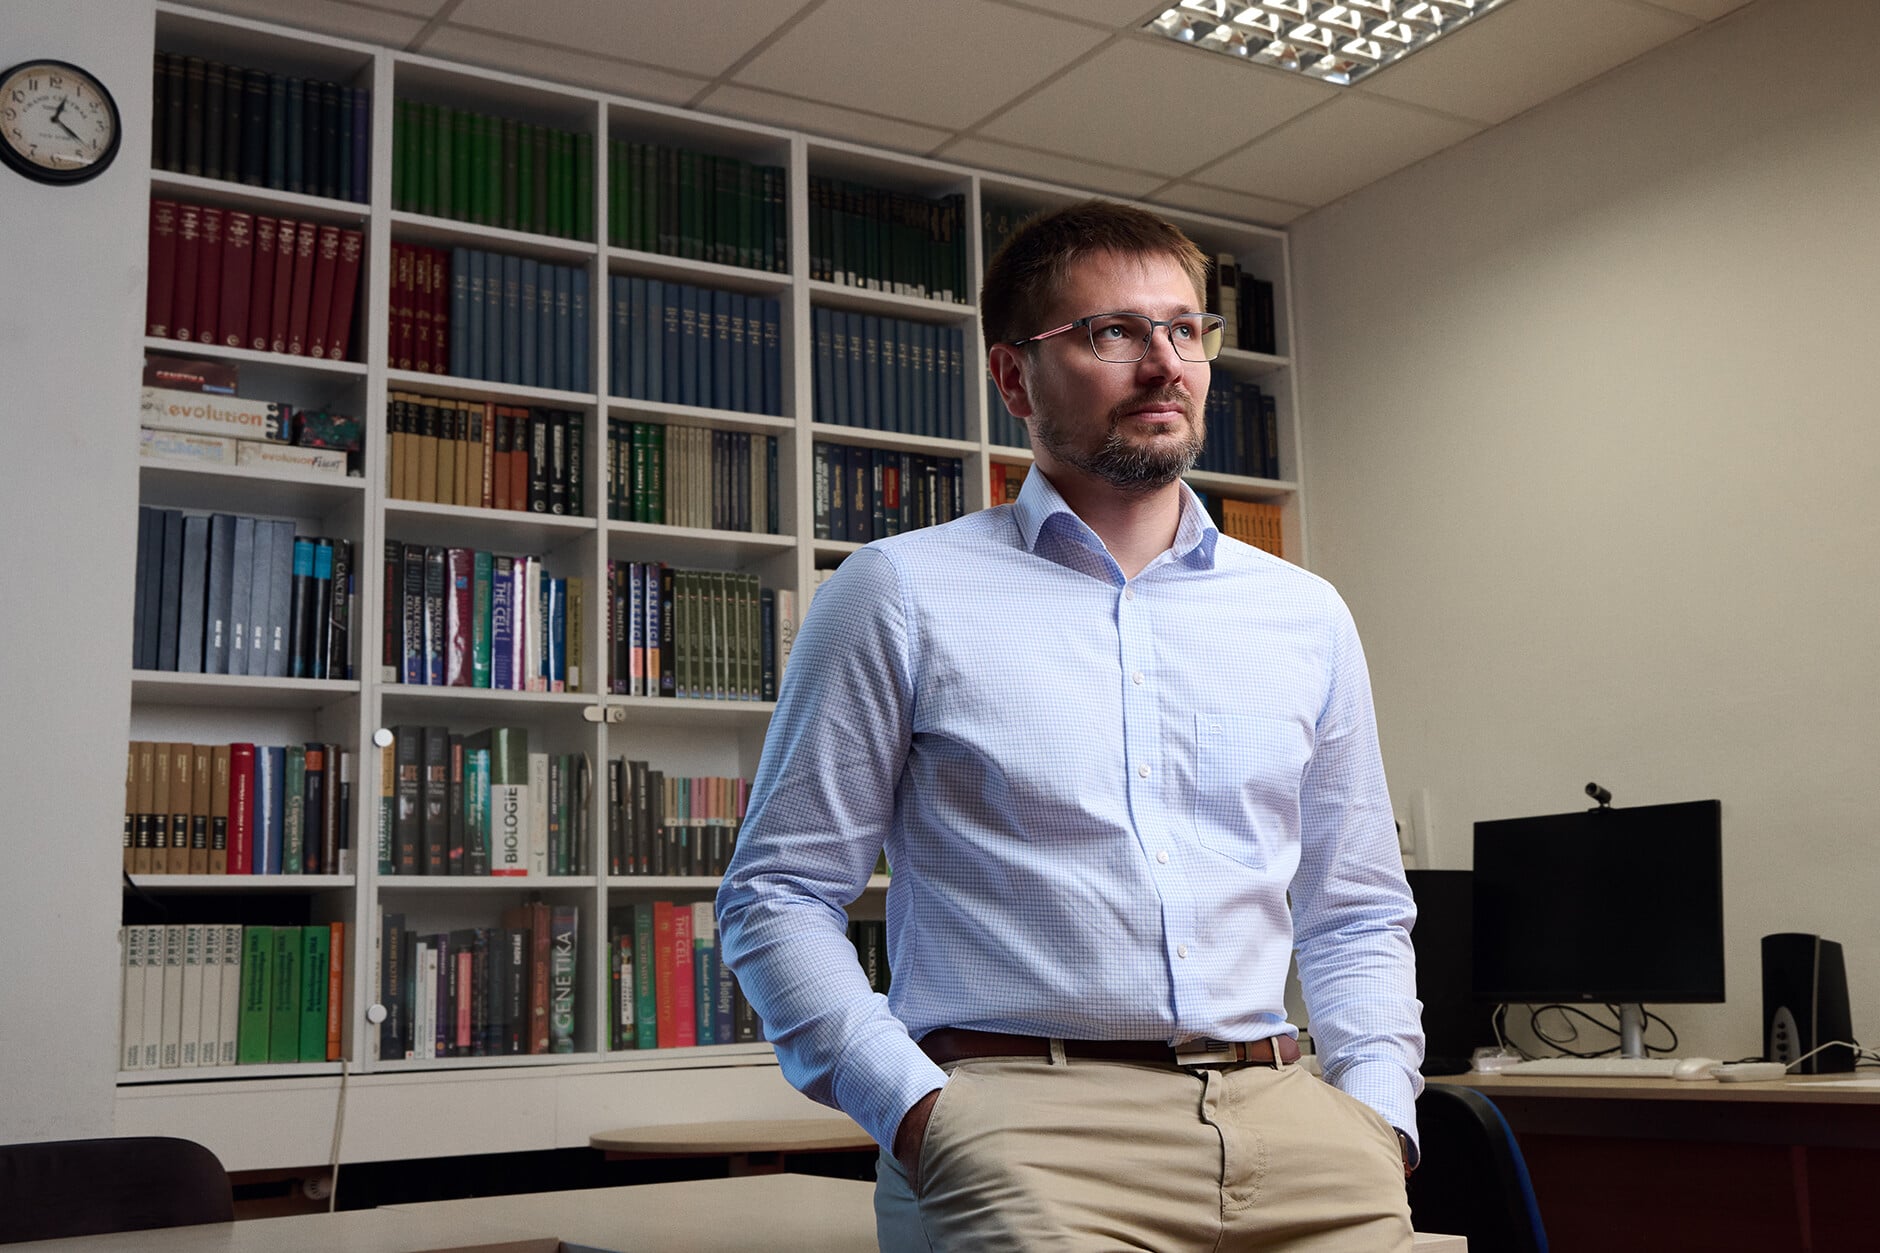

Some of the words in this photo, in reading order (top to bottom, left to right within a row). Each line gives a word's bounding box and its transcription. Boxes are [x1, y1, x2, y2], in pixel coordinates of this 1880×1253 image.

[29, 79, 38, 91] 11
[50, 76, 62, 89] 12
[12, 90, 25, 103] 10
[88, 102, 98, 113] 2
[4, 107, 17, 120] 9
[13, 128, 22, 139] 8
[96, 120, 104, 132] 3
[29, 144, 38, 157] 7
[168, 404, 262, 426] evolution
[334, 562, 346, 607] CANCER
[495, 582, 507, 605] THE
[406, 595, 414, 613] CELL
[633, 578, 641, 646] GENETICS
[650, 580, 659, 647] GENETICS
[413, 596, 421, 651] MOLECULAR
[434, 598, 442, 651] MOLECULAR
[495, 607, 507, 634] CELL
[288, 795, 301, 854] Cytogenetics
[503, 788, 518, 864] BIOLOGIE
[675, 916, 686, 937] THE
[675, 940, 687, 968] CELL
[555, 931, 572, 1029] GENETIKA
[702, 954, 710, 986] Molecular
[703, 987, 711, 1001] Cell
[718, 981, 733, 1014] Biology
[703, 1002, 712, 1027] Biology
